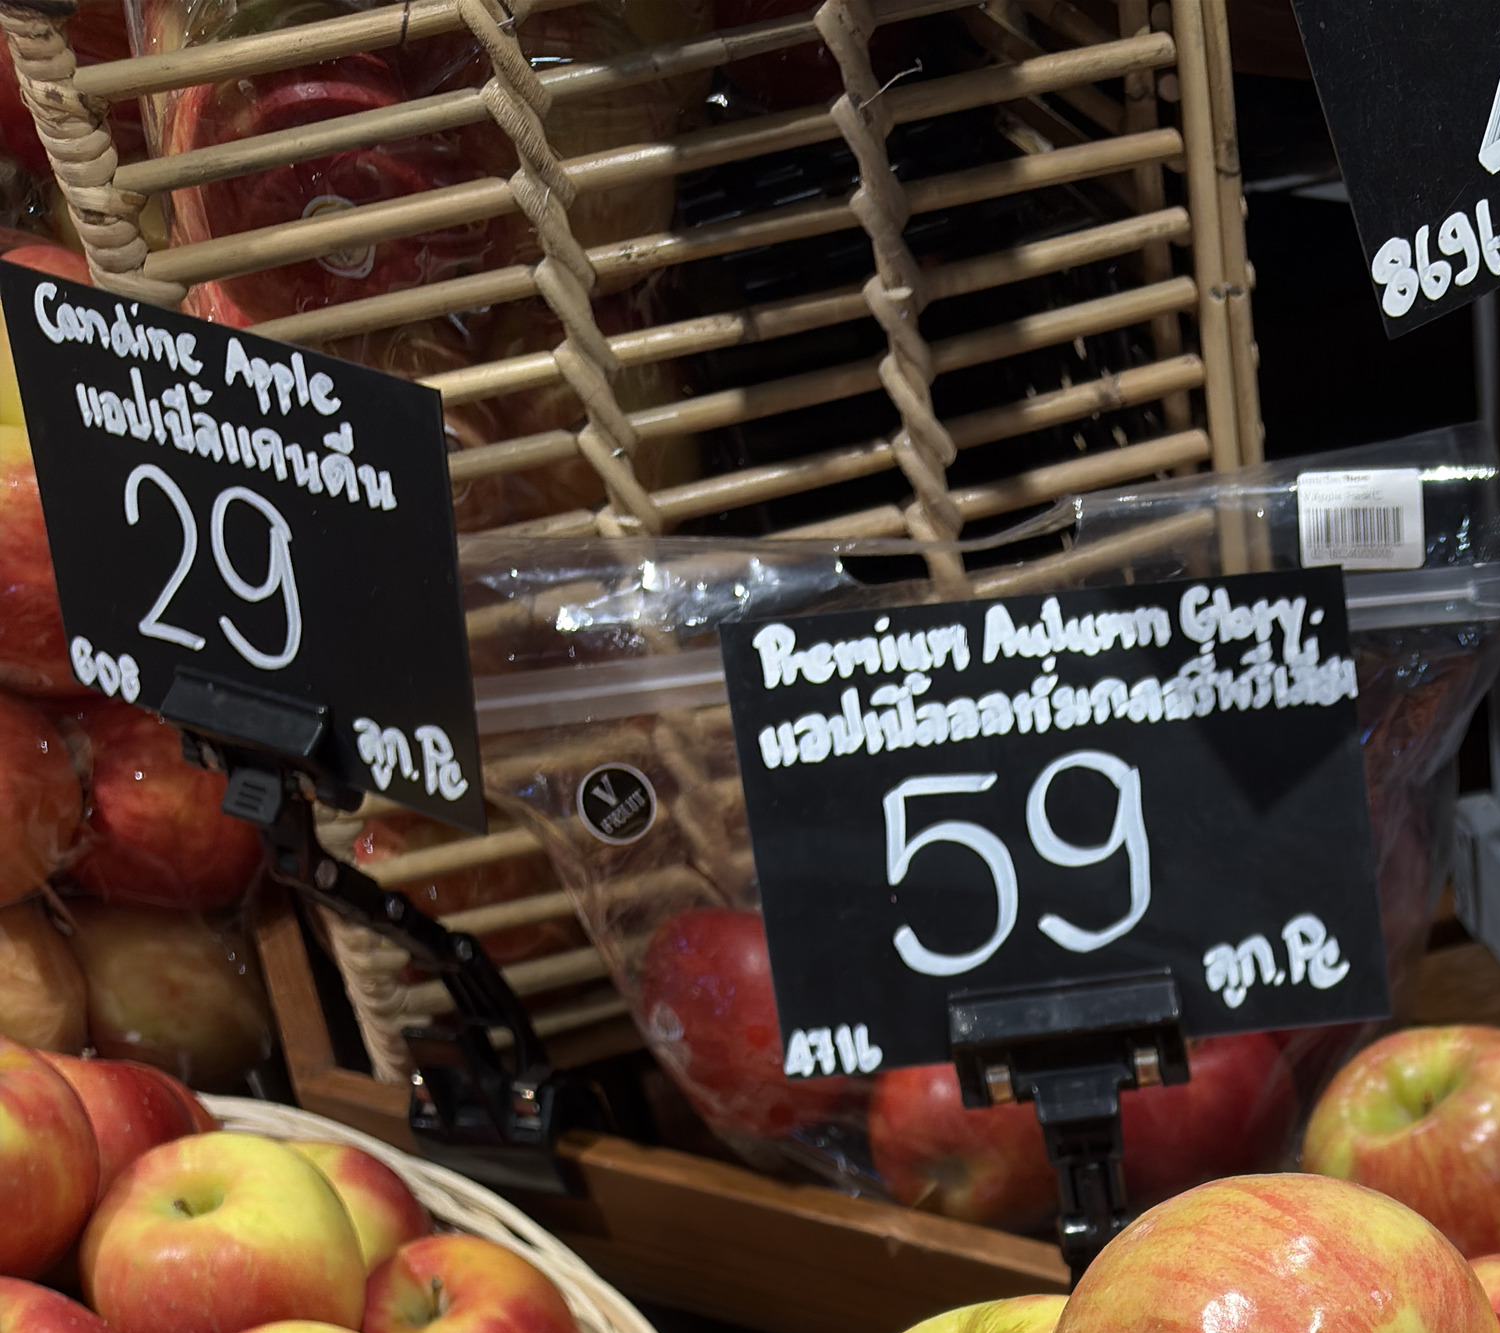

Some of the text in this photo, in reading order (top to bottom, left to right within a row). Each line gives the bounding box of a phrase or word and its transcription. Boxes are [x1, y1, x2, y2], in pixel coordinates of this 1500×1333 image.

[225, 338, 341, 415] Apple
[125, 464, 301, 669] 29
[753, 616, 970, 688] Premium
[983, 596, 1171, 664] Autumn
[883, 751, 1150, 975] 59
